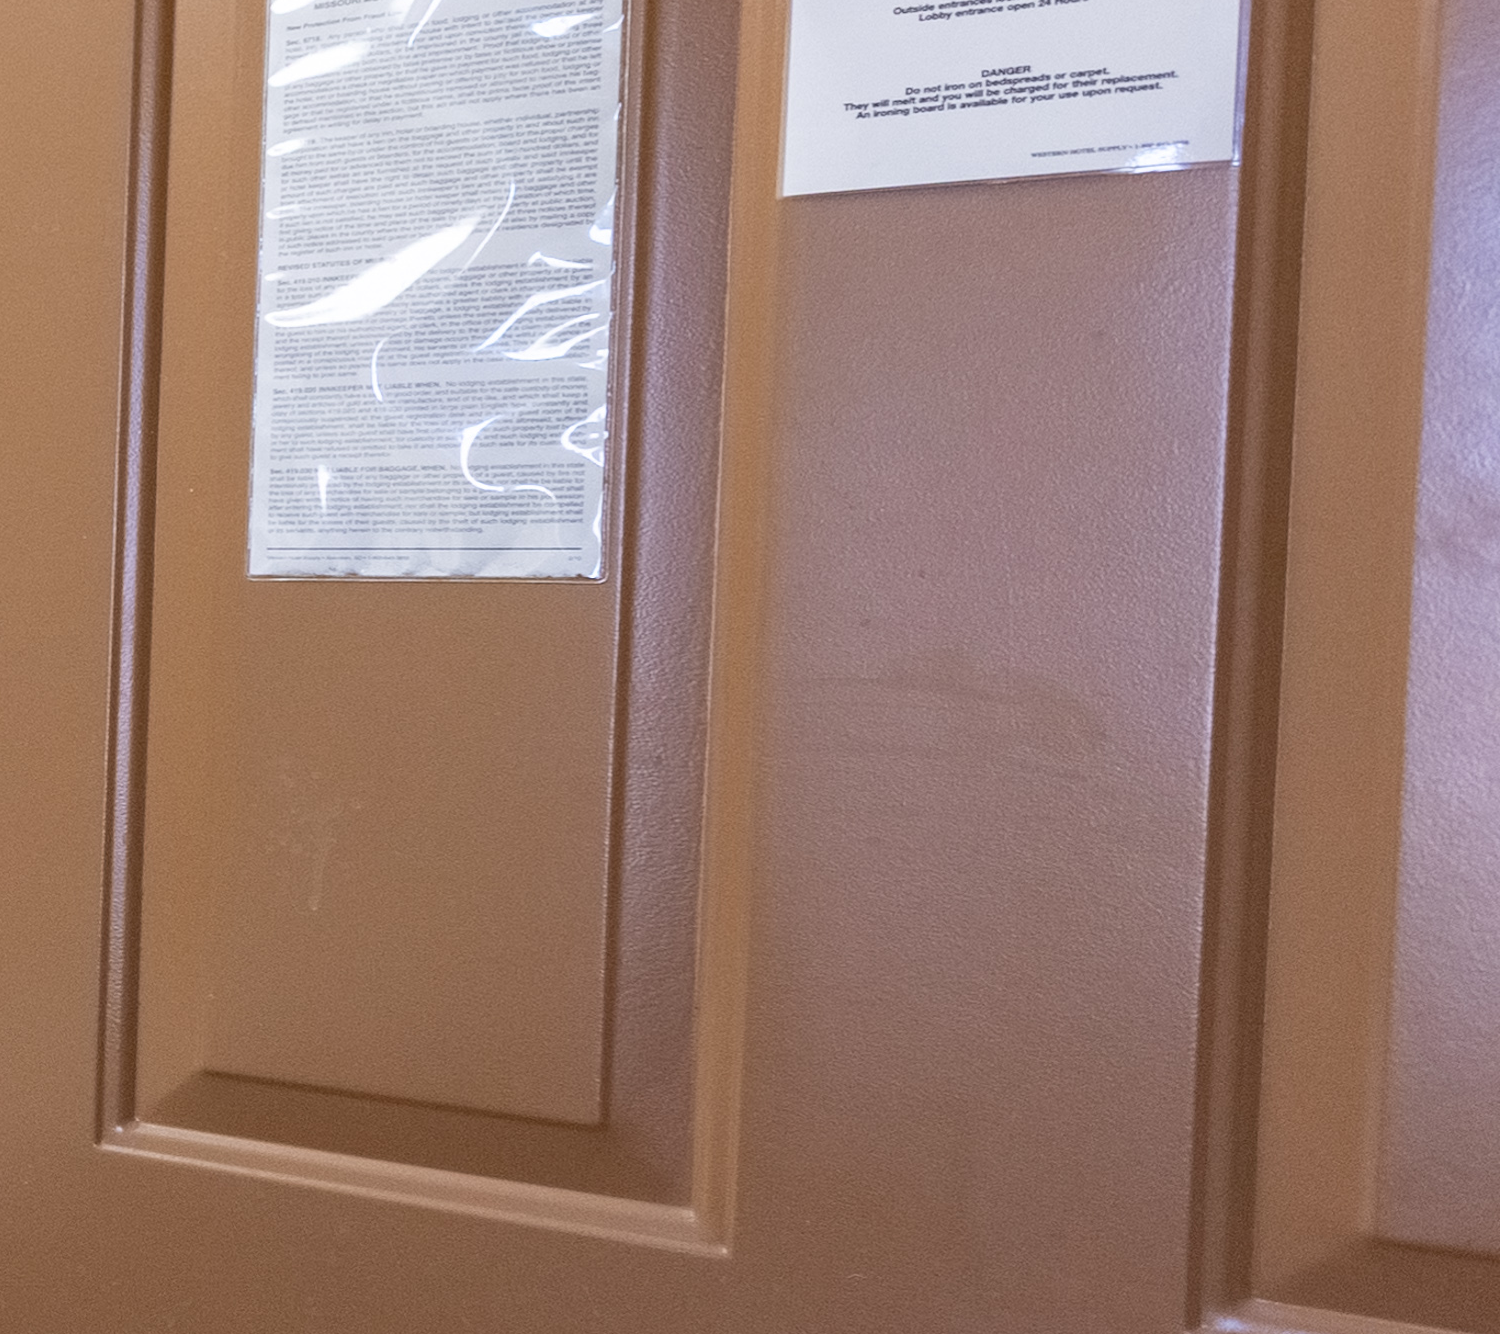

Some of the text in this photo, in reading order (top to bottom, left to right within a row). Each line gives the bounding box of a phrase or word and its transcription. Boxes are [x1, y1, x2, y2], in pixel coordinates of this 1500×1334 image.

[893, 2, 934, 15] Outside
[918, 10, 951, 23] Lobby
[954, 5, 1003, 17] entrance
[1006, 1, 1035, 13] open
[905, 86, 920, 95] Do
[923, 84, 941, 93] not
[944, 81, 964, 91] iron
[985, 73, 1050, 89] bedspreads
[1069, 66, 1110, 80] carpet.
[981, 65, 1031, 77] DANGER
[843, 69, 1179, 112] They will melt and you will be charged for their replacement.
[855, 81, 1163, 119] An ironing board is available for your use upon request.
